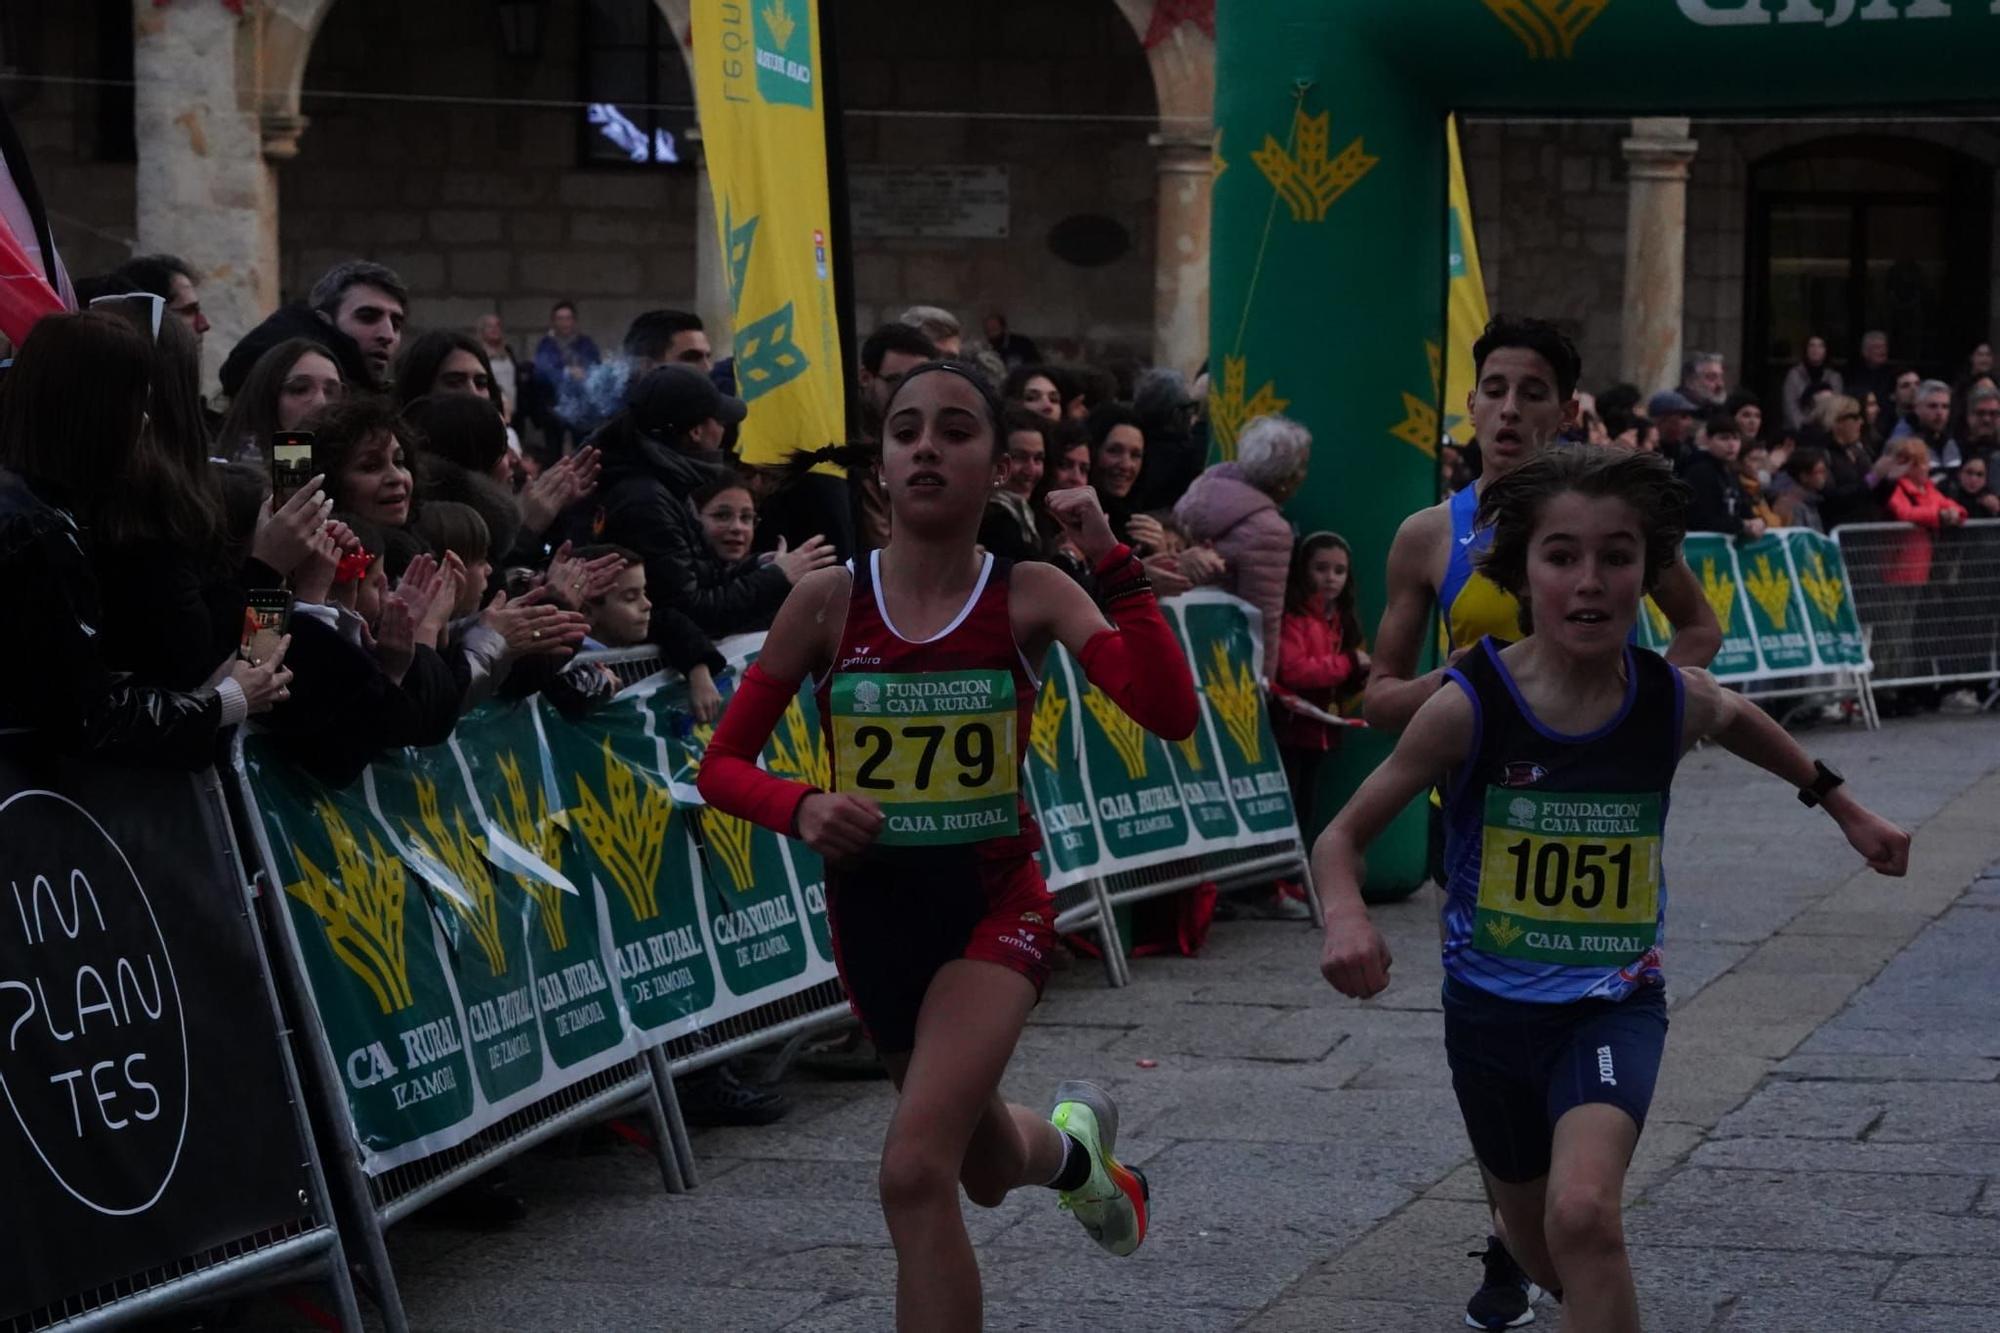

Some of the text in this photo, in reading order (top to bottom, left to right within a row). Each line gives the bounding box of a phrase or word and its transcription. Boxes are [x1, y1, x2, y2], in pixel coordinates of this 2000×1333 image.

[886, 680, 992, 697] FUNDACION
[886, 695, 992, 713] CAJA RURAL
[854, 723, 995, 790] 279
[888, 808, 1008, 833] CAJA RURAL
[1541, 802, 1641, 818] FUNDACION
[1541, 818, 1639, 833] CAJA RURAL
[1508, 838, 1632, 909] 1051
[11, 868, 106, 945] IM
[747, 894, 797, 936] RURAL
[614, 924, 703, 980] AJA RURAL
[998, 935, 1042, 960] amura
[1525, 932, 1645, 953] CAJA RURAL
[0, 953, 162, 1052] PLAN
[538, 972, 568, 1012] CAJA
[631, 979, 653, 1005] DE
[469, 1000, 501, 1043] CAJA
[399, 1015, 462, 1070] RURAL
[50, 1052, 161, 1138] TES
